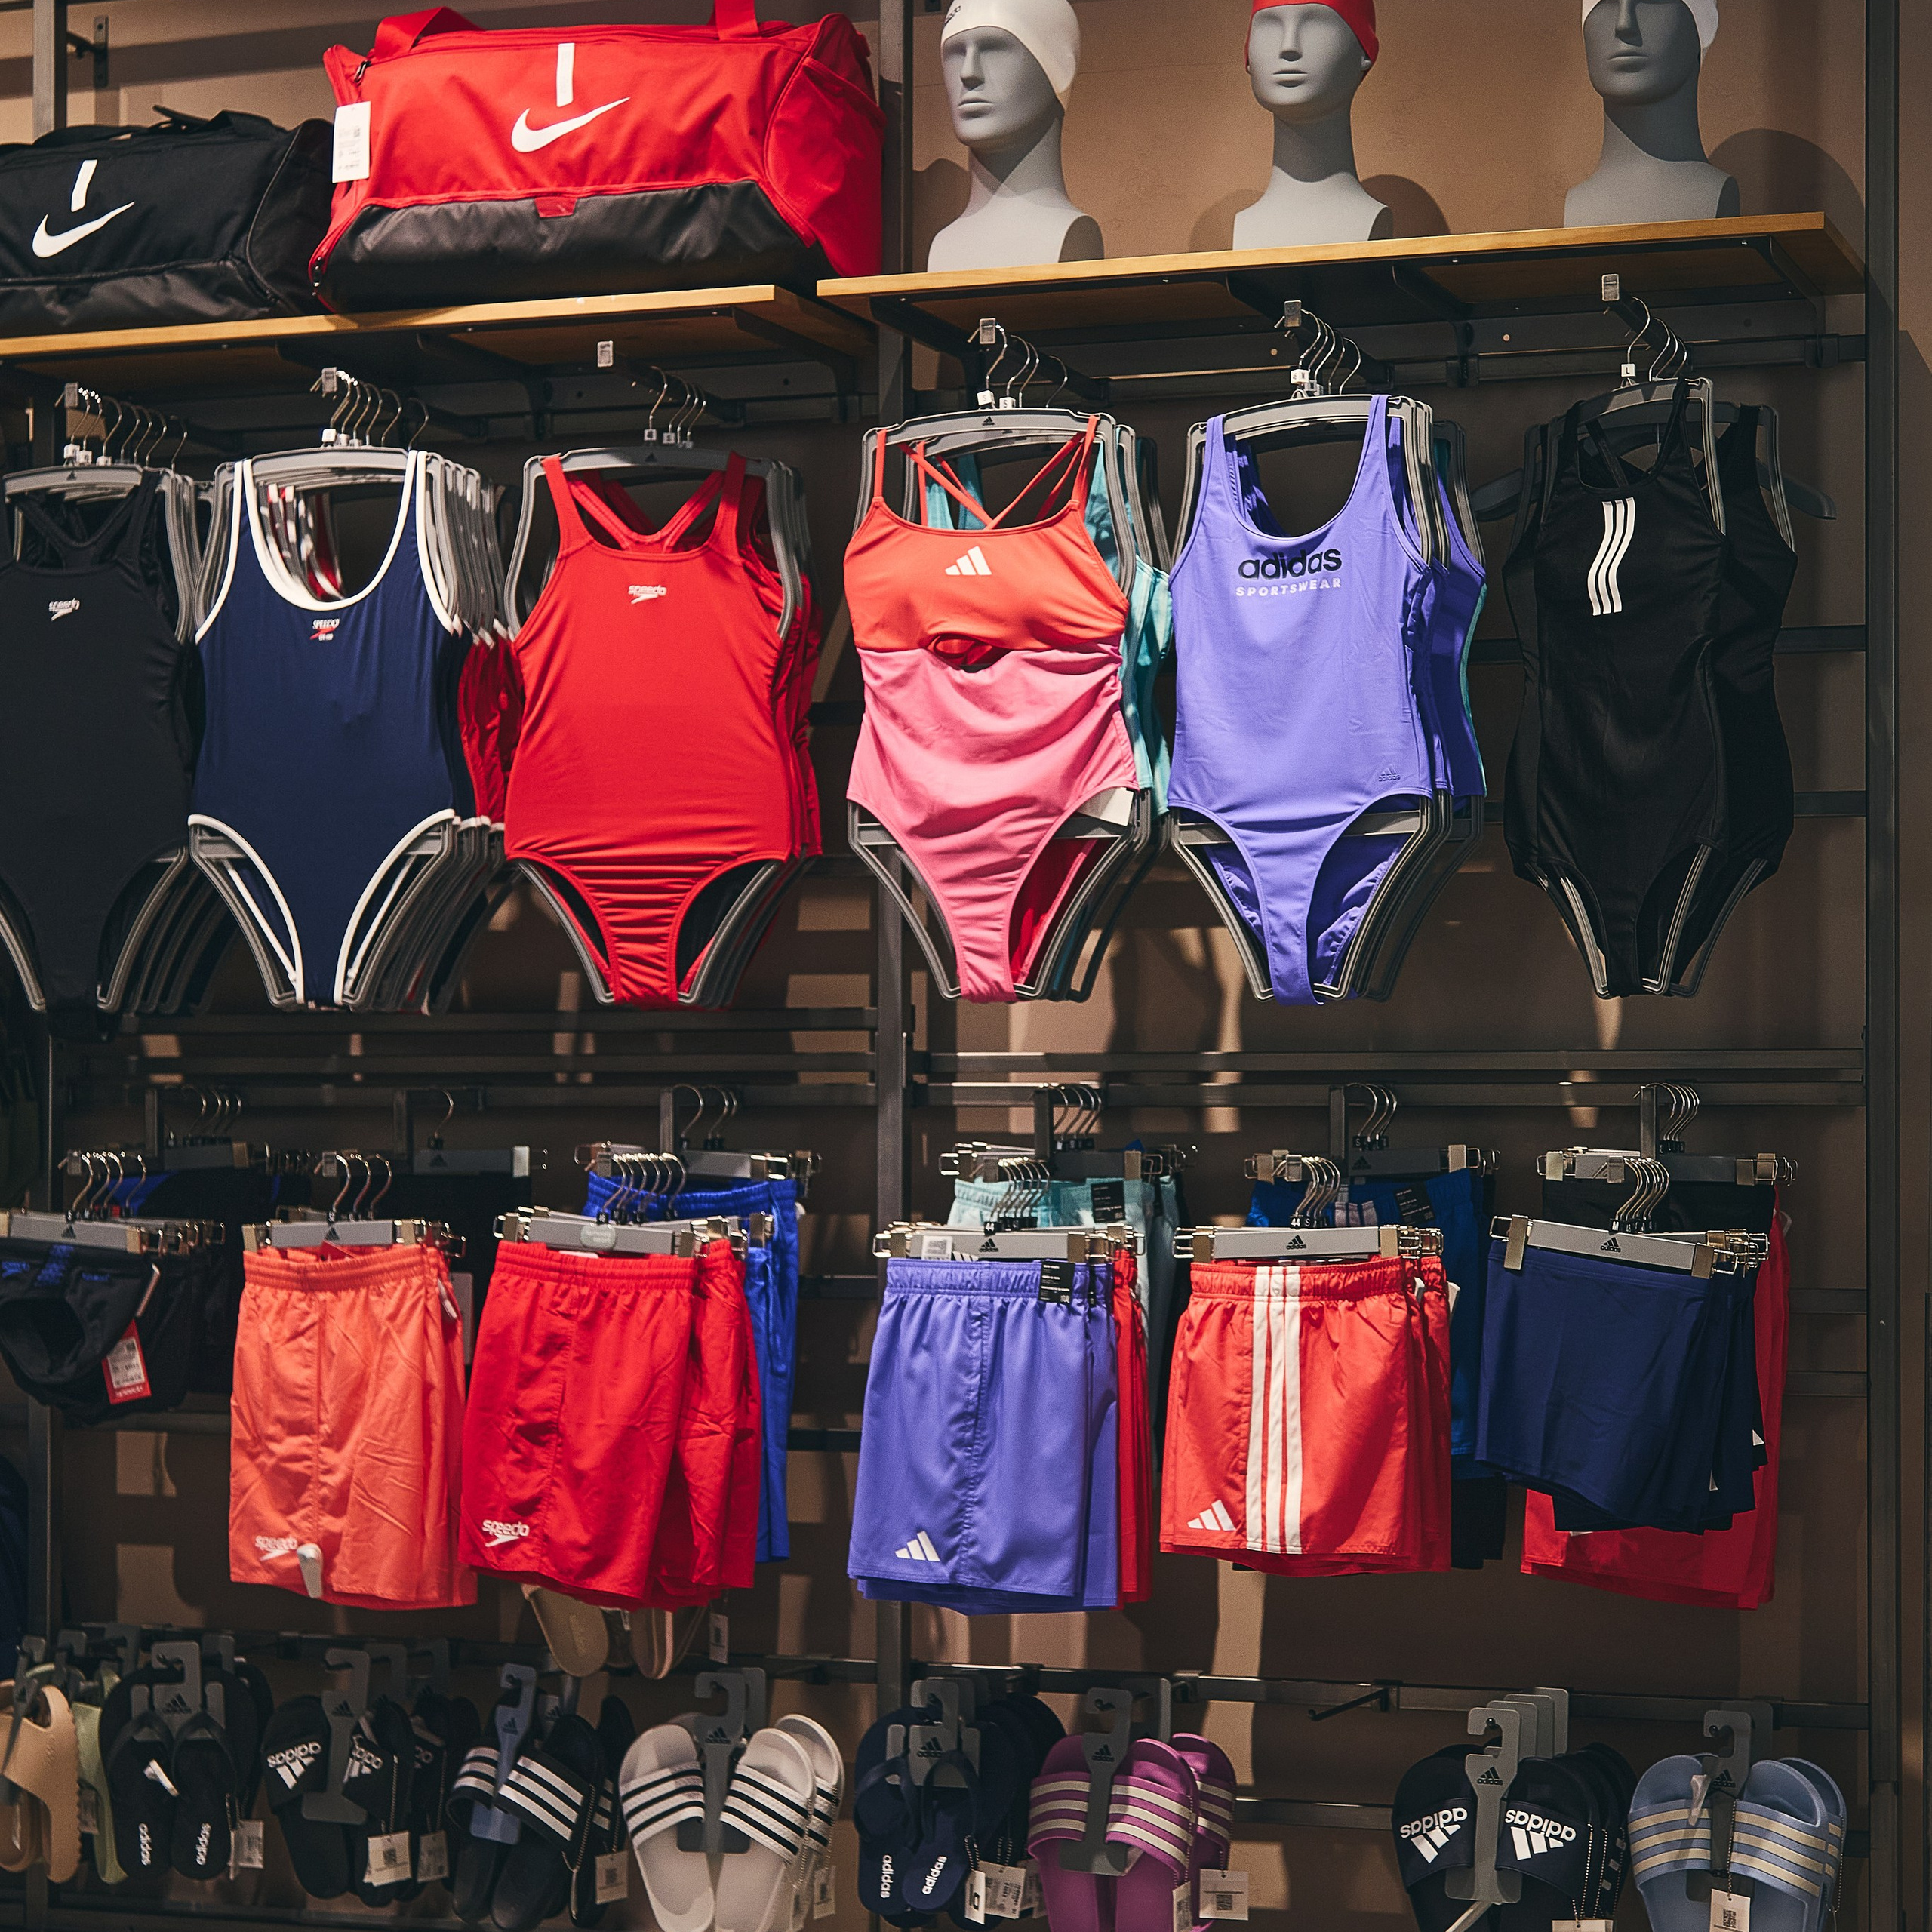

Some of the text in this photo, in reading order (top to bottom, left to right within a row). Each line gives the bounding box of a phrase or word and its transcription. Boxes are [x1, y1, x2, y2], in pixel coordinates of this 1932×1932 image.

[1626, 366, 1631, 374] L
[1003, 399, 1008, 408] S
[1238, 549, 1343, 580] adidas
[628, 584, 667, 596] speedo
[1235, 577, 1342, 597] SPORTSWEAR
[1291, 1217, 1301, 1227] 44
[1304, 1218, 1311, 1227] S
[481, 1519, 531, 1537] speedo
[254, 1534, 298, 1552] speedo
[266, 1740, 322, 1768] adidas
[1400, 1807, 1468, 1839] adidas
[1504, 1809, 1577, 1842] adidas
[138, 1823, 152, 1866] adidas
[196, 1823, 211, 1866] adidas
[880, 1854, 894, 1899] adidas
[921, 1855, 948, 1895] adidas
